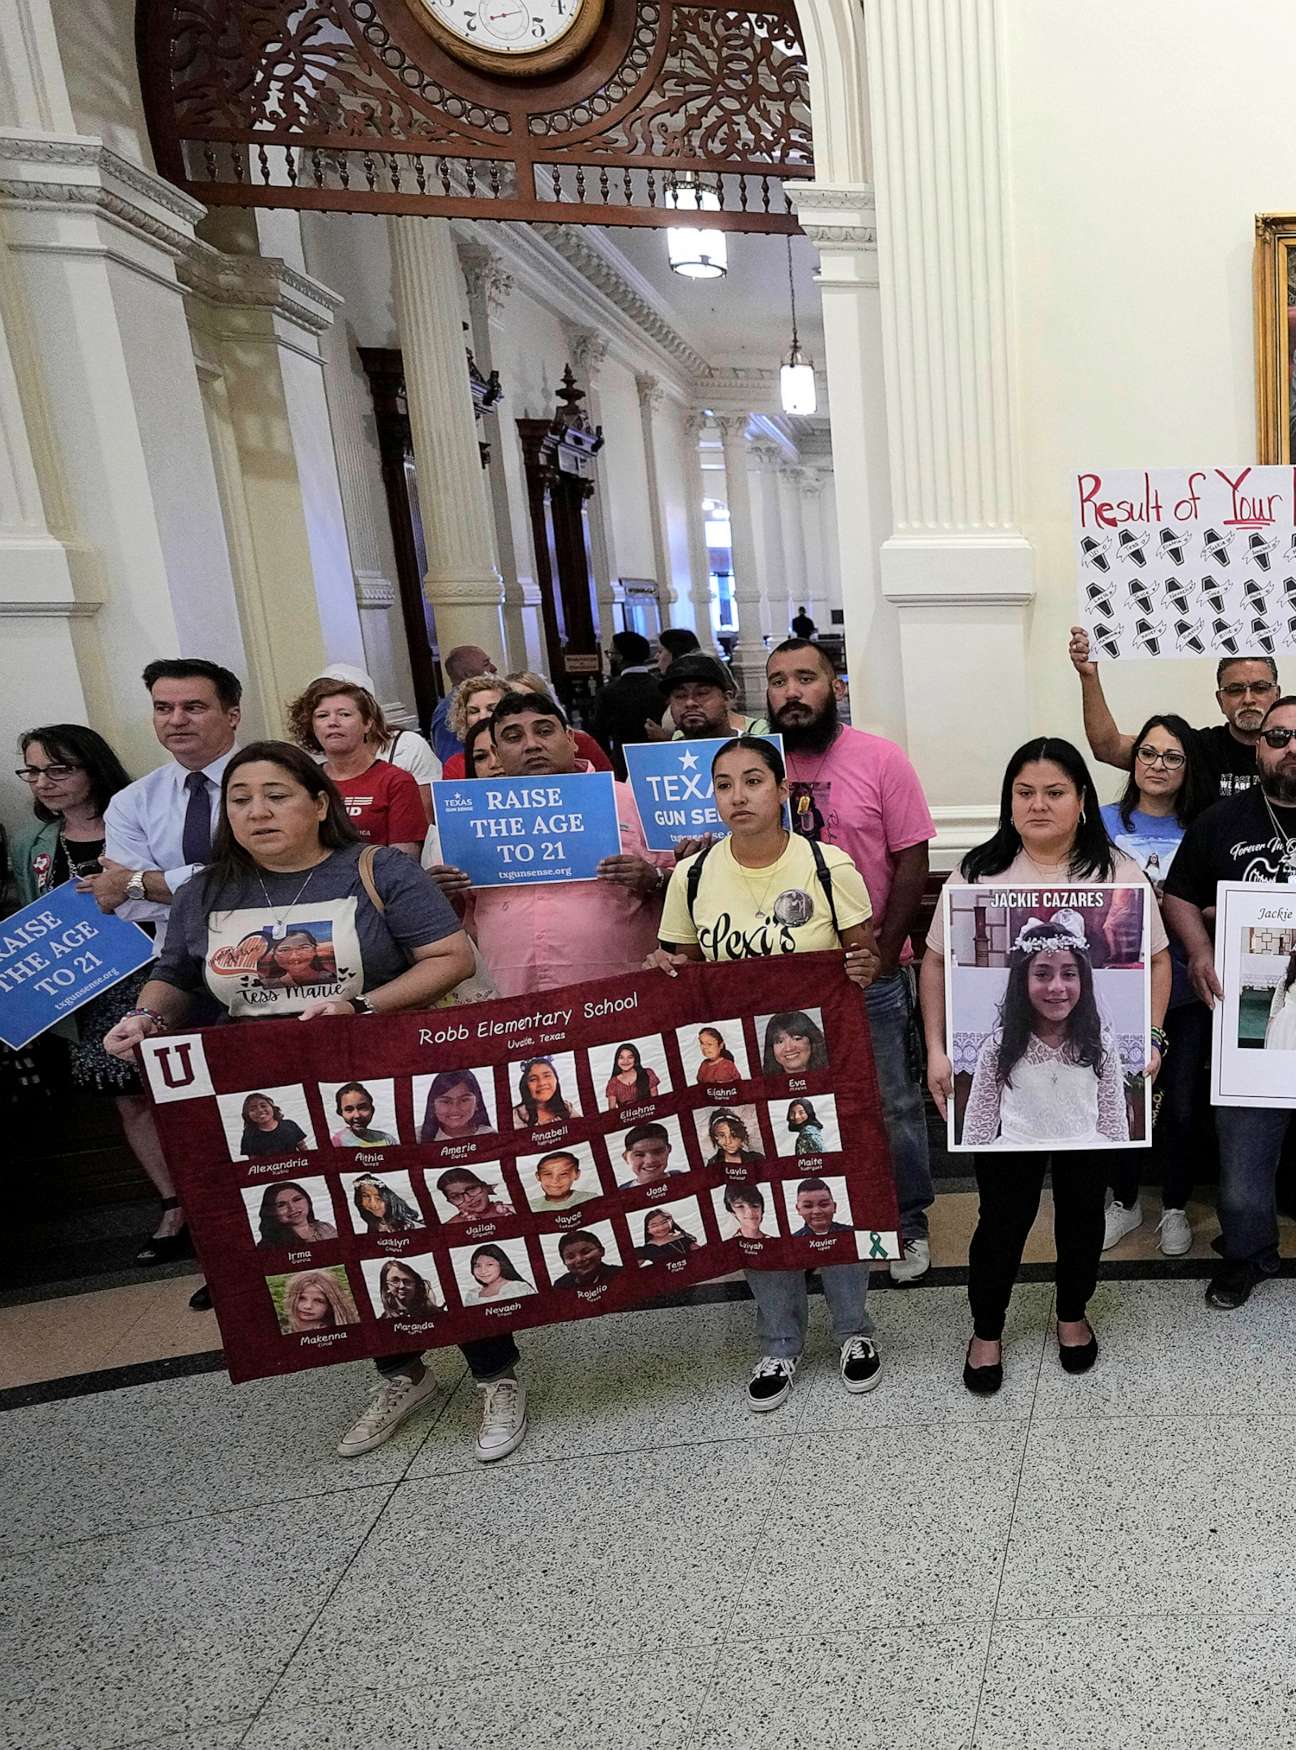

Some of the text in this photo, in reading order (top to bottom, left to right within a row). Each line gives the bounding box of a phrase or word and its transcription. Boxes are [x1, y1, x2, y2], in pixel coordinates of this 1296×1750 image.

[1078, 472, 1162, 529] Result
[1174, 472, 1206, 521] of
[1214, 467, 1283, 521] Your
[444, 798, 473, 807] TEXAS
[486, 788, 563, 811] RAISE
[655, 810, 686, 826] GUN
[470, 814, 585, 839] THE AGE
[497, 841, 566, 863] TO 21
[1229, 841, 1266, 861] Forever
[1267, 837, 1284, 853] In
[498, 866, 573, 881] txgunsense.org
[991, 891, 1104, 908] JACKIE CAZARES
[1257, 907, 1294, 921] Jackie
[0, 911, 62, 962] AISE
[0, 921, 99, 993] THE AGE
[34, 951, 103, 997] TO 21
[55, 967, 120, 1010] txgunsense.org
[237, 982, 346, 1004] Tess Marie
[419, 992, 638, 1046] Robb Elementary School
[539, 1031, 566, 1044] Texas
[153, 1043, 195, 1089] U
[789, 1079, 806, 1088] Eva
[620, 1103, 657, 1120] Eliahna
[531, 1126, 569, 1142] Annabell
[440, 1142, 477, 1157] Amerie
[248, 1158, 309, 1175] Alexandria
[798, 1158, 823, 1168] Maite
[725, 1167, 748, 1177] Layla
[646, 1183, 669, 1197] José
[555, 1211, 583, 1224] Jayce
[466, 1223, 496, 1235] Jailah
[809, 1237, 838, 1248] Xavier
[288, 1250, 312, 1261] Irma
[666, 1259, 688, 1270] Tess
[577, 1284, 608, 1299] Rojelio
[485, 1302, 522, 1316] Nevaeh
[394, 1321, 435, 1332] Maranda
[300, 1332, 348, 1346] Makenna
